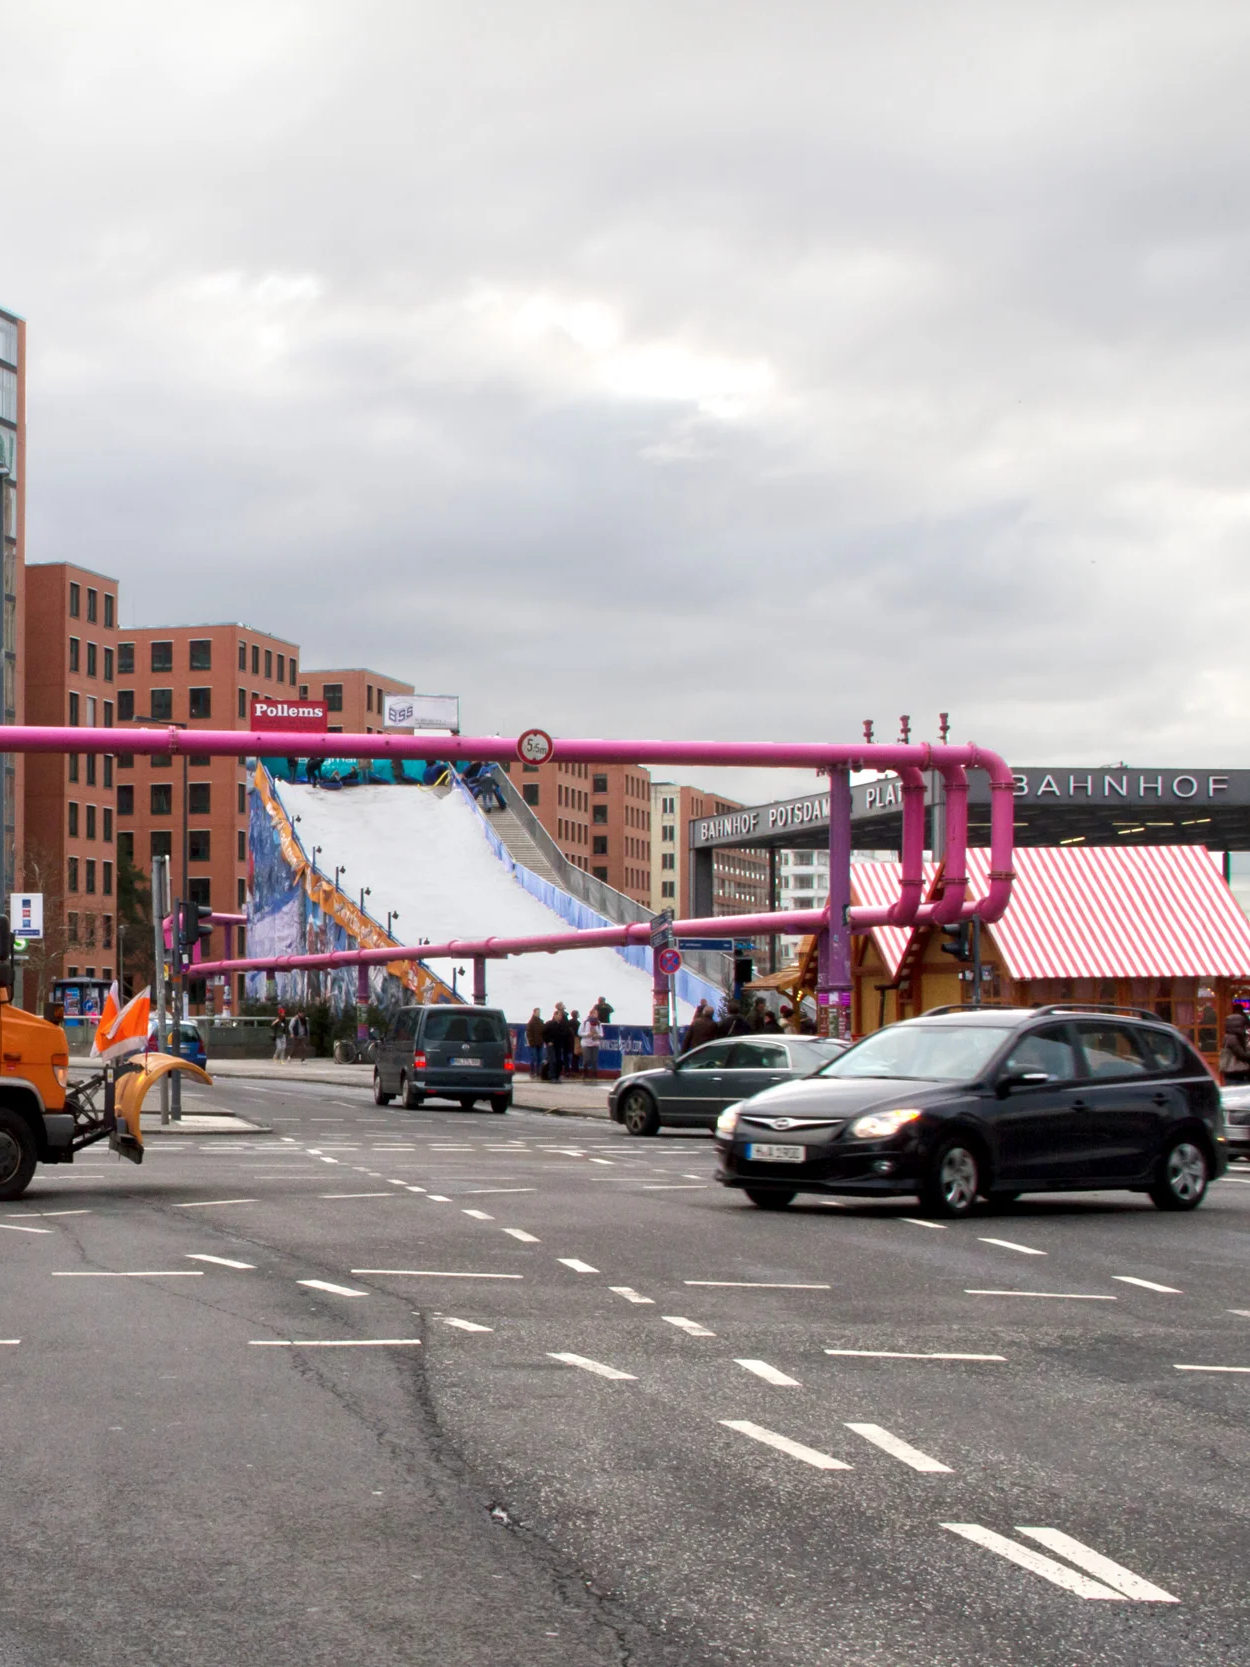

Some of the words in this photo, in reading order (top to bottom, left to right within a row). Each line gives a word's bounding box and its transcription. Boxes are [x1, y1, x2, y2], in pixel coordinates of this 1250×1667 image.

[255, 703, 323, 717] Pollems
[389, 705, 413, 723] BSS
[1012, 774, 1229, 798] BAHNHOF
[701, 812, 759, 841] BAHNHOF
[768, 796, 830, 829] POTSDAM
[866, 782, 904, 809] PLAT
